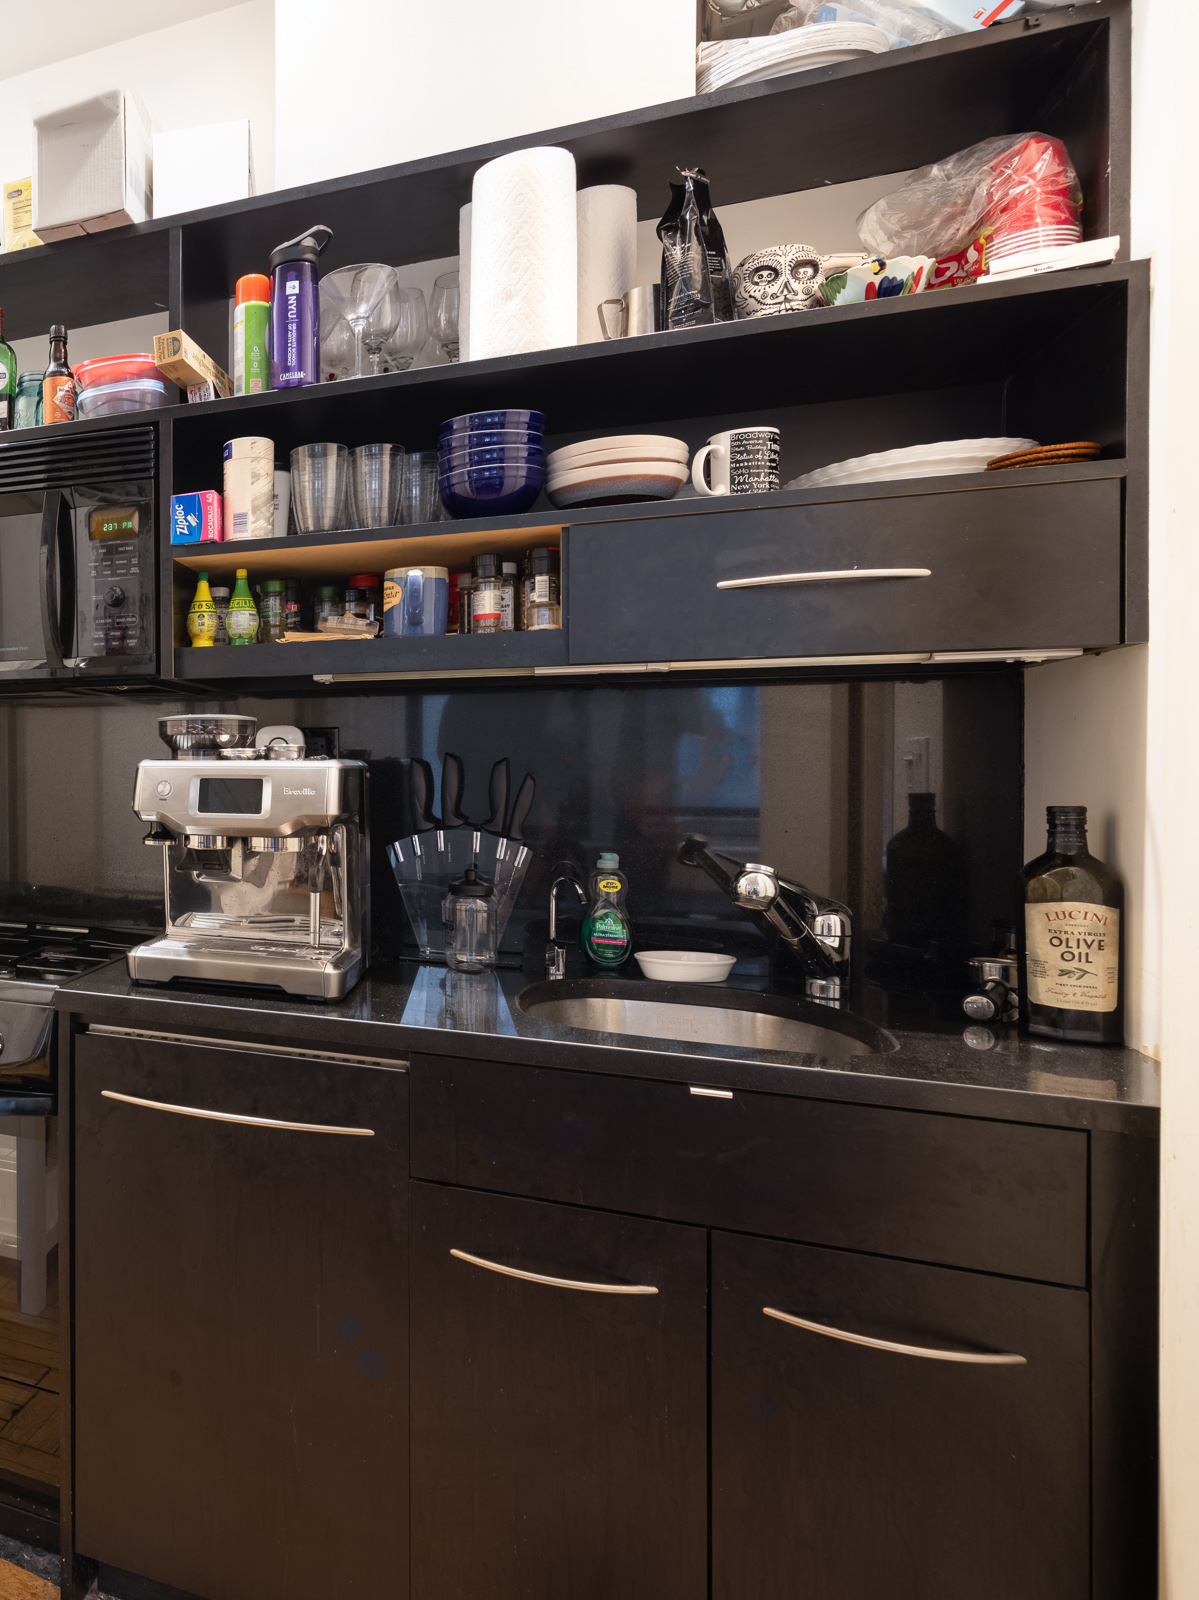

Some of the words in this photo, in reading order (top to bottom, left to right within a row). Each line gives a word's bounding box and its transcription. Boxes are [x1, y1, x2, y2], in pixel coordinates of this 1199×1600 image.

[287, 295, 297, 318] NYU
[730, 432, 774, 440] Broadway
[730, 452, 754, 461] Statue
[754, 450, 763, 459] of
[206, 493, 213, 503] 40
[174, 503, 189, 535] Ziploc
[103, 523, 118, 531] 2:37
[283, 786, 316, 796] Breville
[1044, 909, 1108, 927] LUCINI
[596, 922, 622, 931] Palmolive
[1048, 928, 1075, 936] EXTRA
[1049, 935, 1105, 951] OLIVE
[1060, 950, 1094, 964] OIL
